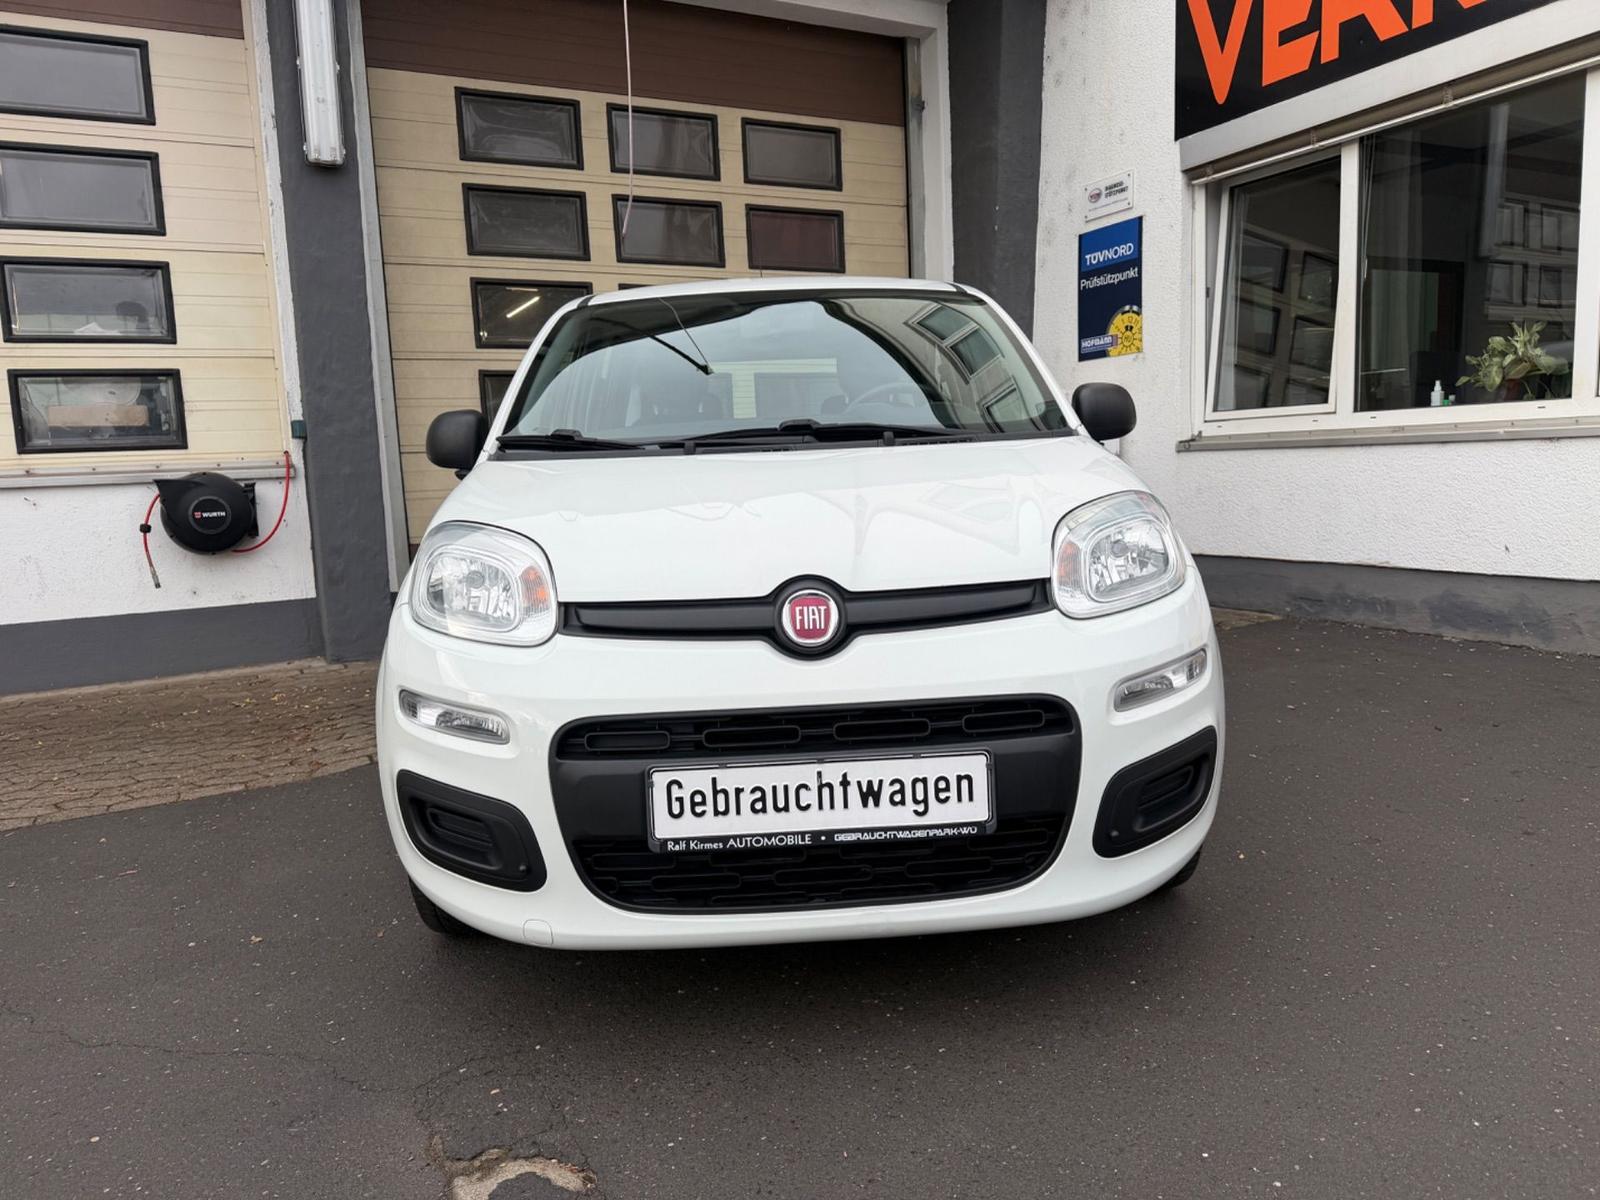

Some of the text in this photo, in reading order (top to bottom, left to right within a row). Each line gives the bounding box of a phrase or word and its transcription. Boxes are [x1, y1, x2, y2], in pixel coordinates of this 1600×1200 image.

[1080, 267, 1138, 291] Prüfstützpunkt
[795, 606, 827, 630] FIAT
[666, 770, 974, 819] Gebrauchtwagen
[667, 840, 687, 851] Ralf
[689, 840, 724, 850] Kirmes
[726, 834, 813, 849] AUTOMOBILE
